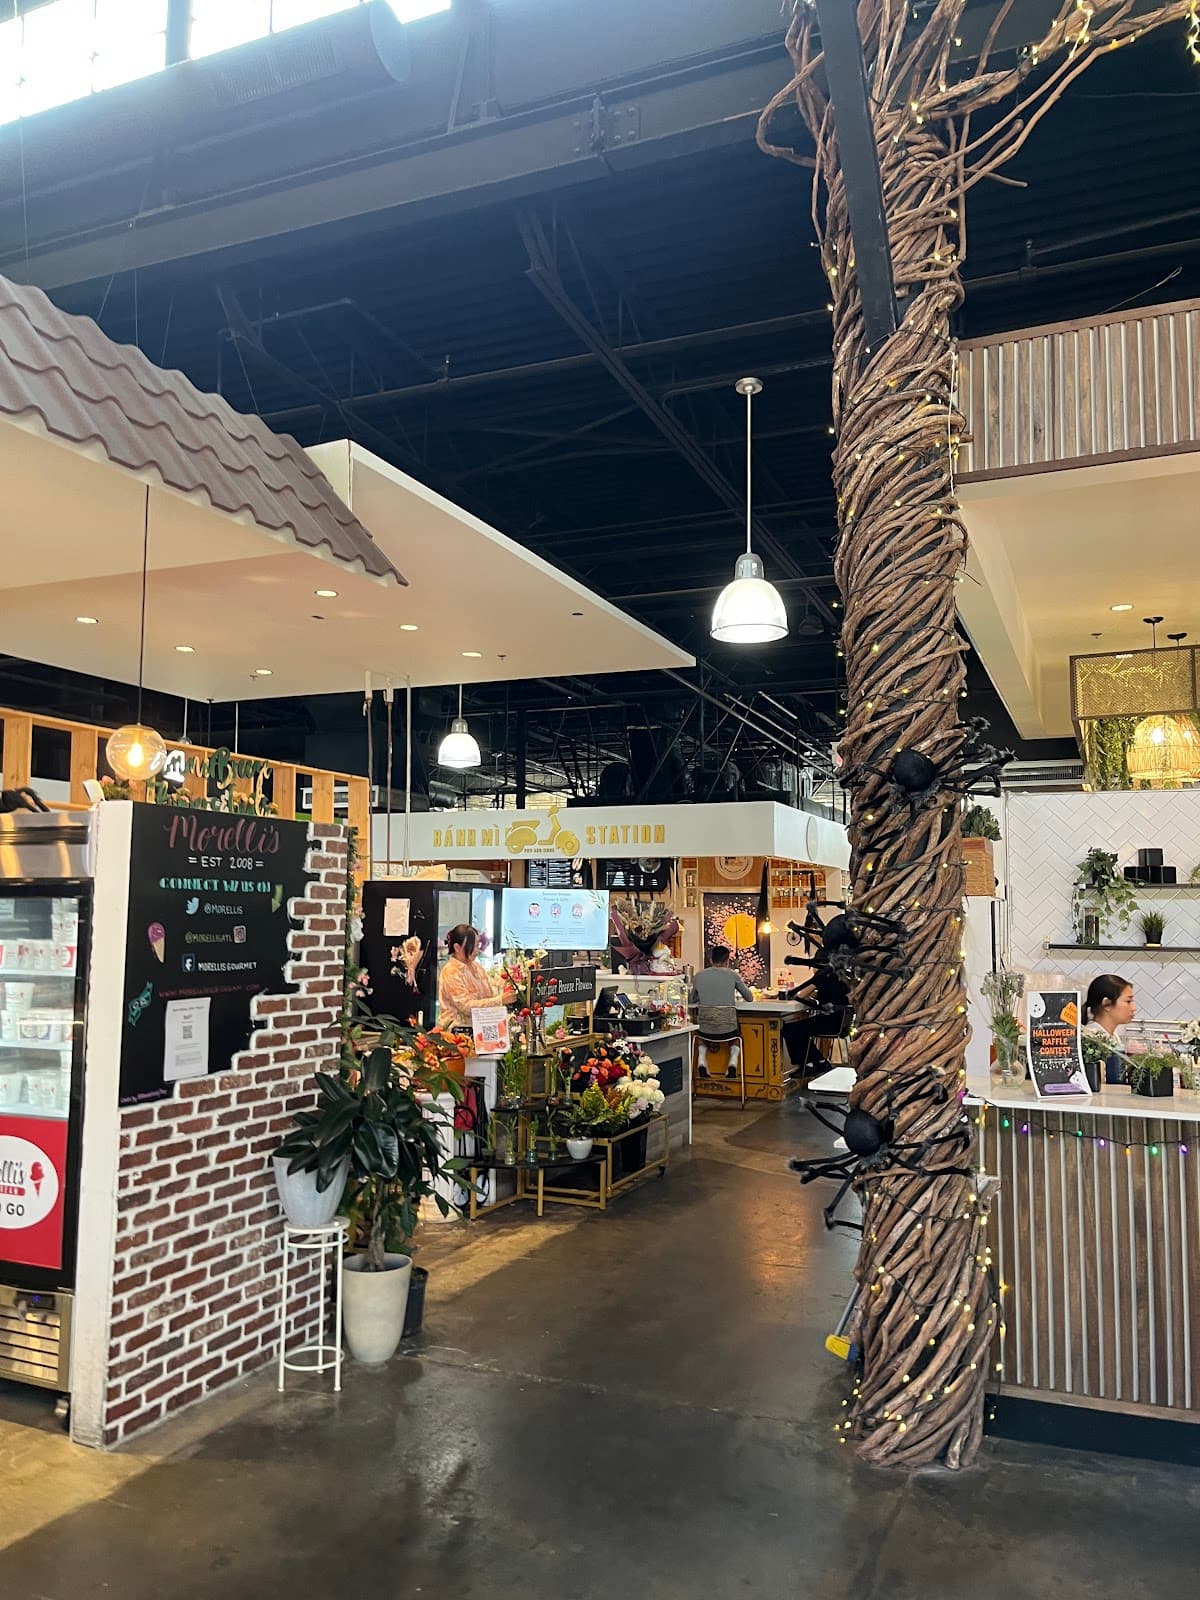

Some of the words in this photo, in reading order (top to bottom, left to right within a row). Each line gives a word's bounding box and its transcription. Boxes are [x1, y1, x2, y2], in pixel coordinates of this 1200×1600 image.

[163, 815, 280, 853] Morelli's
[433, 824, 477, 847] BÁNH
[586, 824, 665, 844] STATION
[201, 856, 222, 868] EST
[229, 857, 254, 870] 2008
[159, 877, 219, 891] CONNECT
[204, 903, 244, 915] @MORELLIS
[558, 980, 575, 994] Breeze
[575, 978, 593, 991] Flowers
[1032, 1028, 1076, 1038] HALLOWEEN
[1042, 1038, 1069, 1046] RAFFLE
[1039, 1046, 1072, 1055] CONTEST
[0, 1160, 24, 1185] lli's
[6, 1202, 25, 1217] GO
